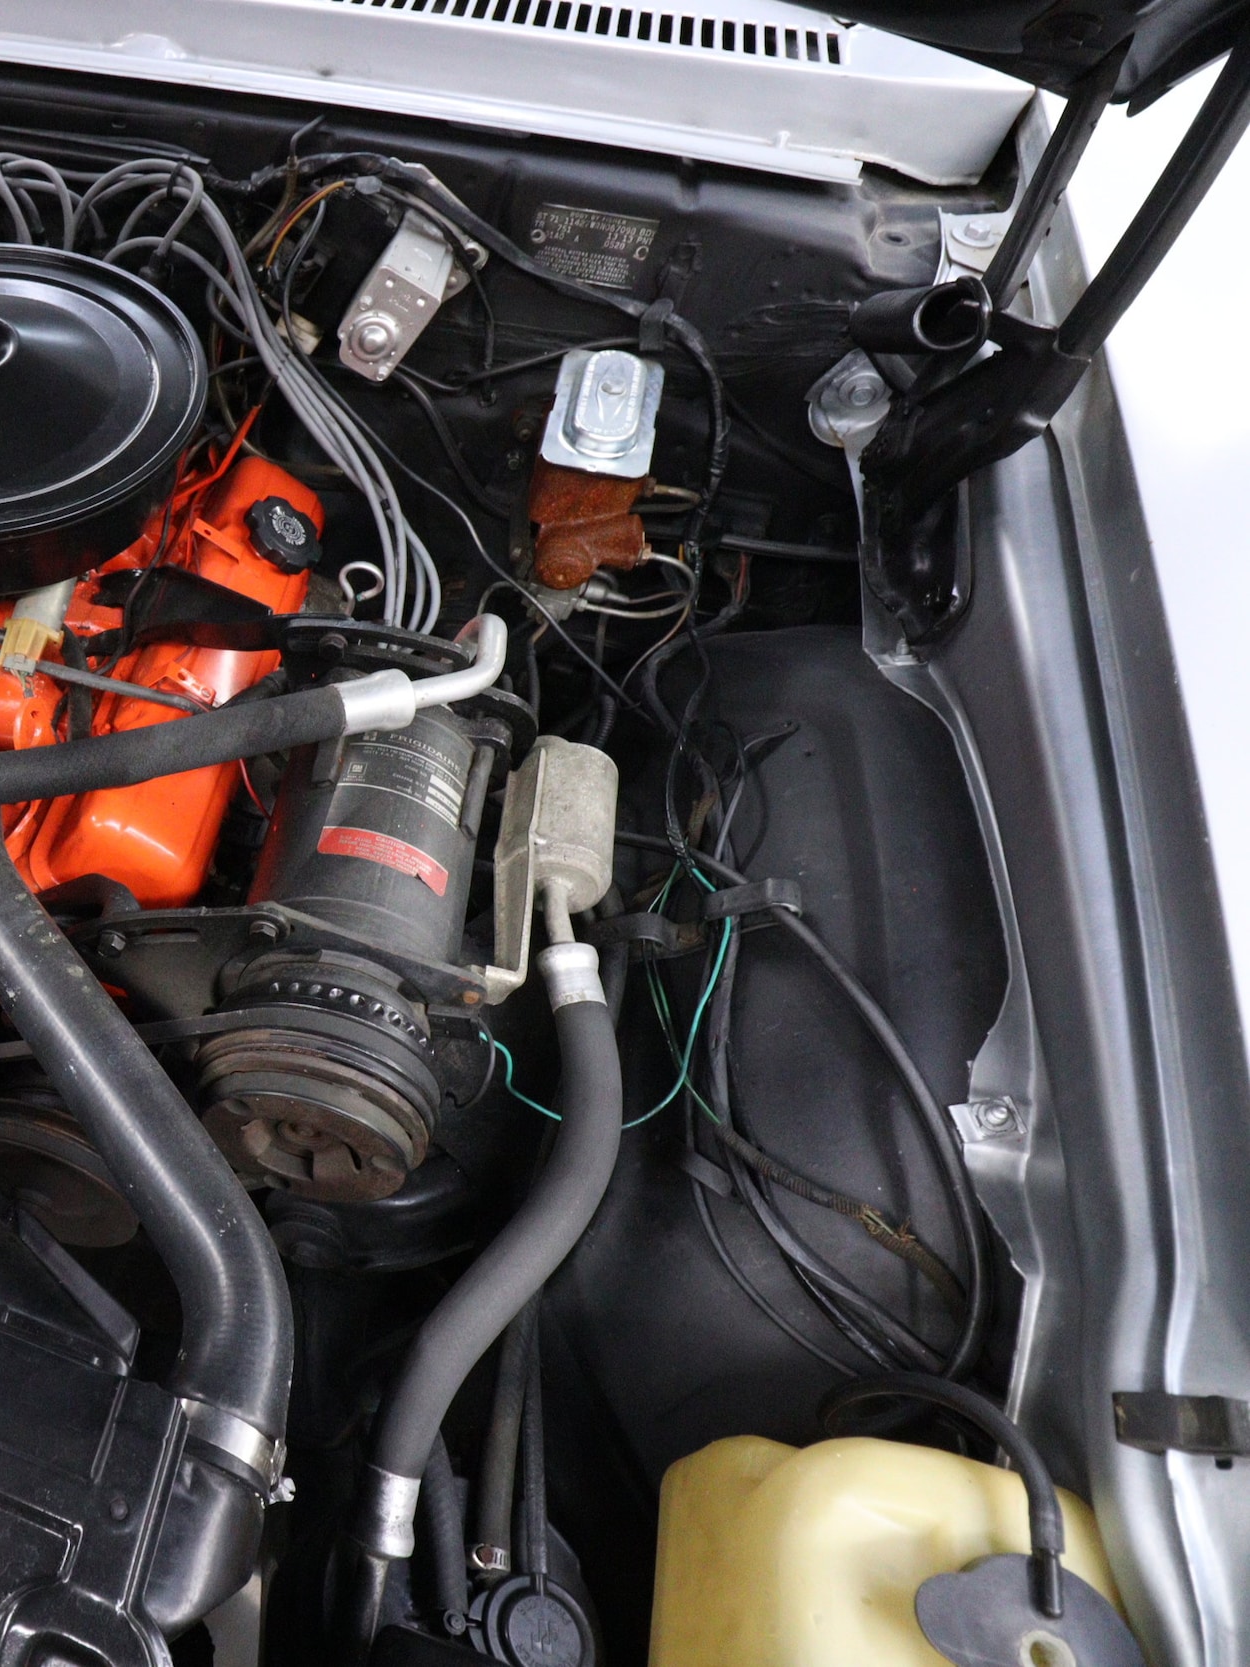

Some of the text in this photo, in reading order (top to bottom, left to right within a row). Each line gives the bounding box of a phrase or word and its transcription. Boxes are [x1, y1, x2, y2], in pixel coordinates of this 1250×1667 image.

[549, 214, 560, 223] 71
[557, 223, 572, 233] 751
[390, 734, 461, 771] FRIGIDAIRE
